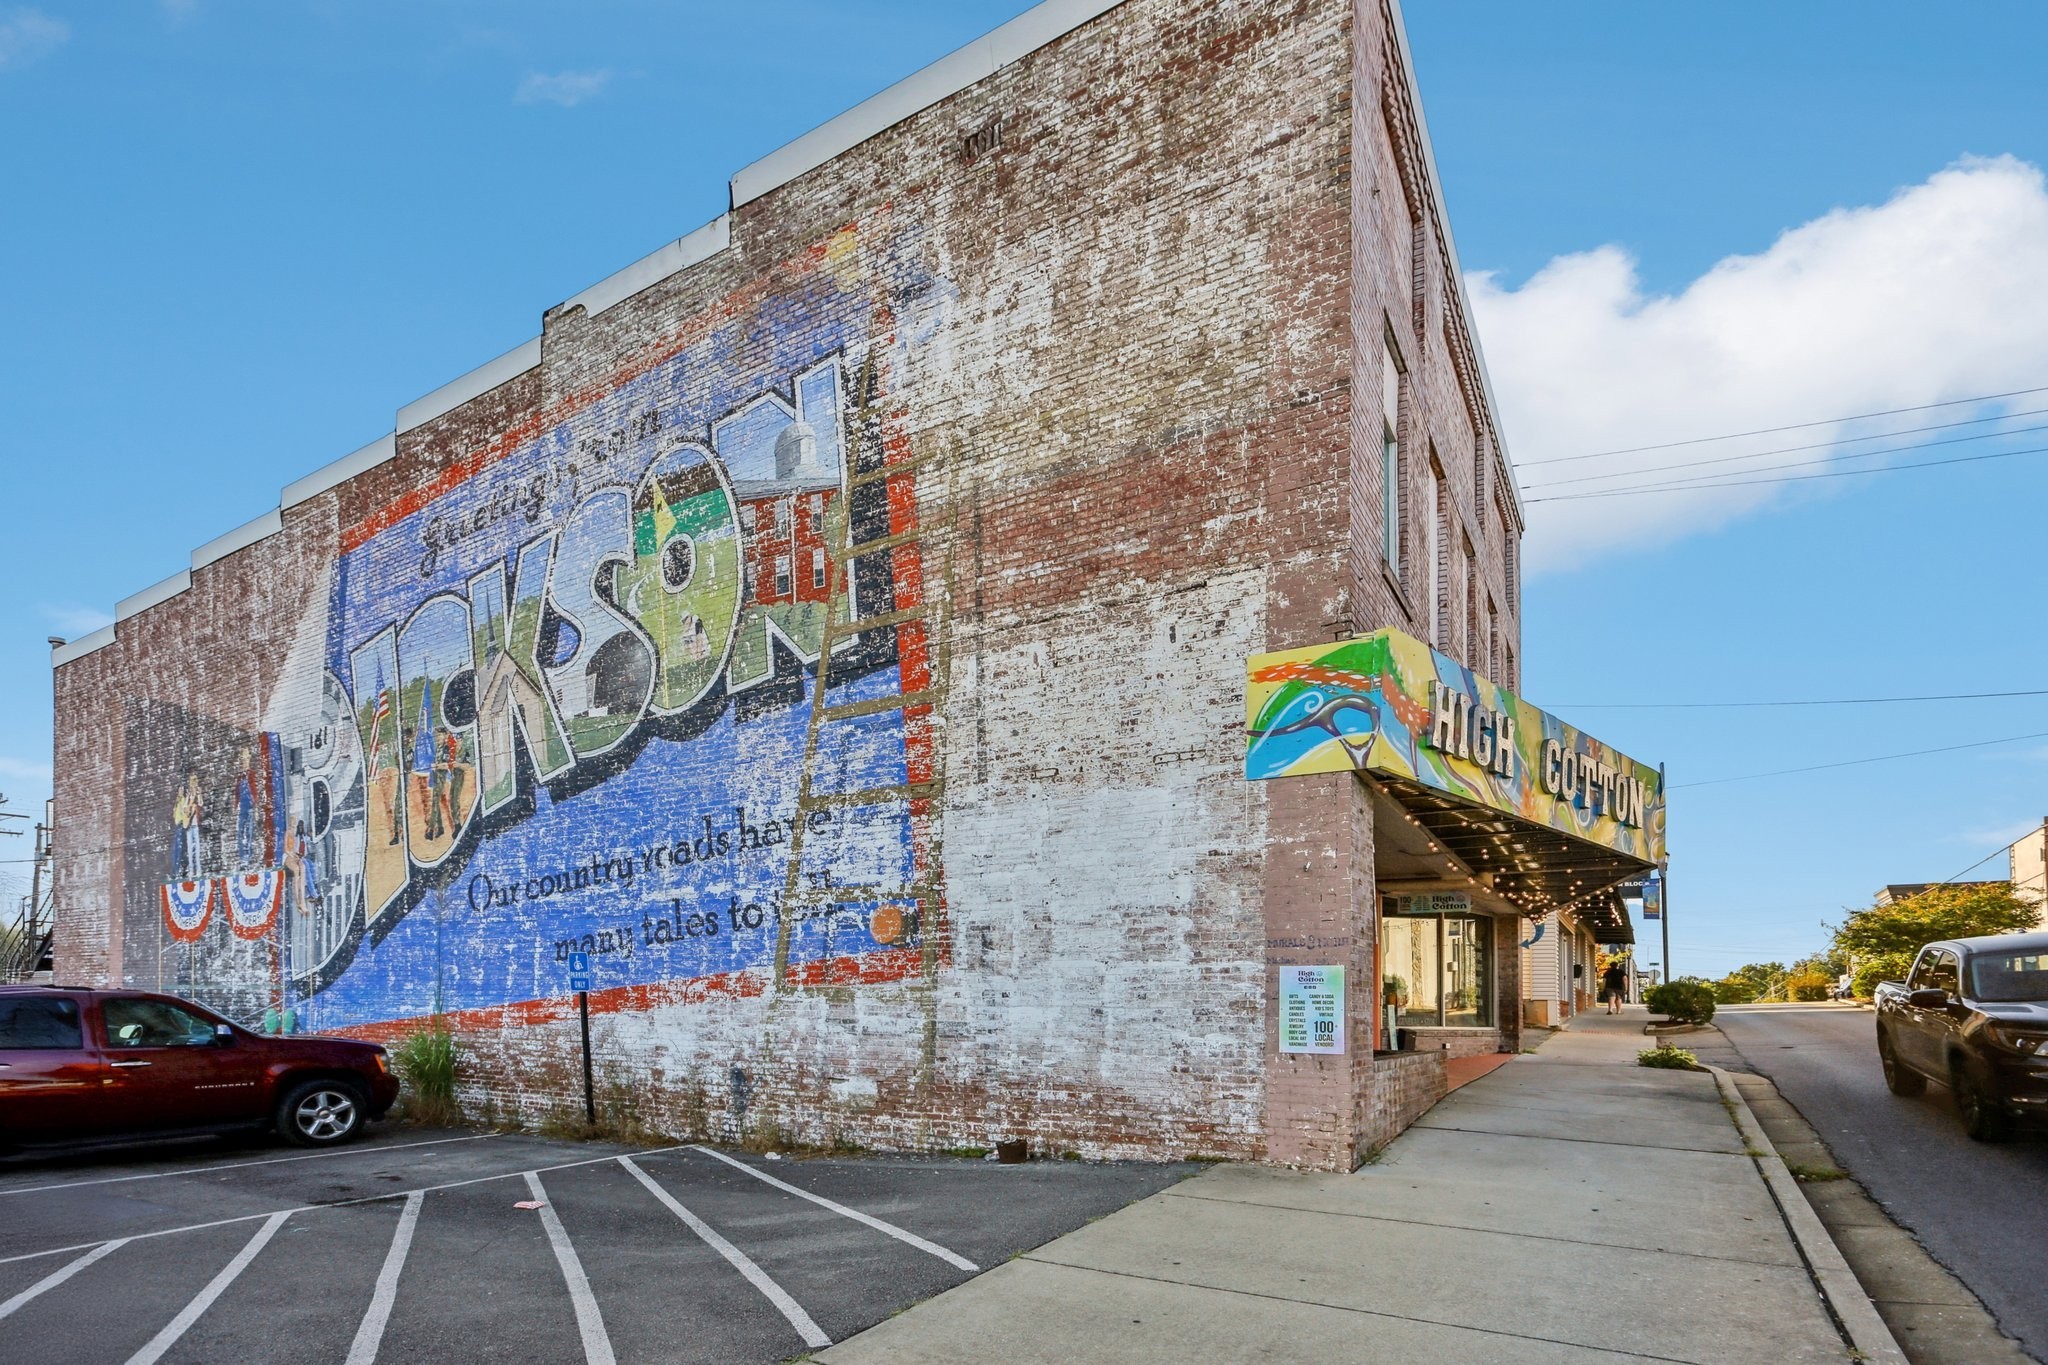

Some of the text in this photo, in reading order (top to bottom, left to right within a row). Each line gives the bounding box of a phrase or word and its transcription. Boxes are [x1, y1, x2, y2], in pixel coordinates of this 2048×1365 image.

[1428, 679, 1645, 830] HIGH COTTON
[467, 872, 517, 913] Our
[524, 856, 634, 902] country
[644, 814, 730, 874] roads
[1432, 895, 1455, 905] High
[1432, 902, 1468, 911] Cotton
[555, 922, 634, 964] many
[642, 898, 720, 946] tales
[728, 899, 763, 932] to
[1298, 970, 1315, 979] High
[1315, 1034, 1335, 1042] LOCAL
